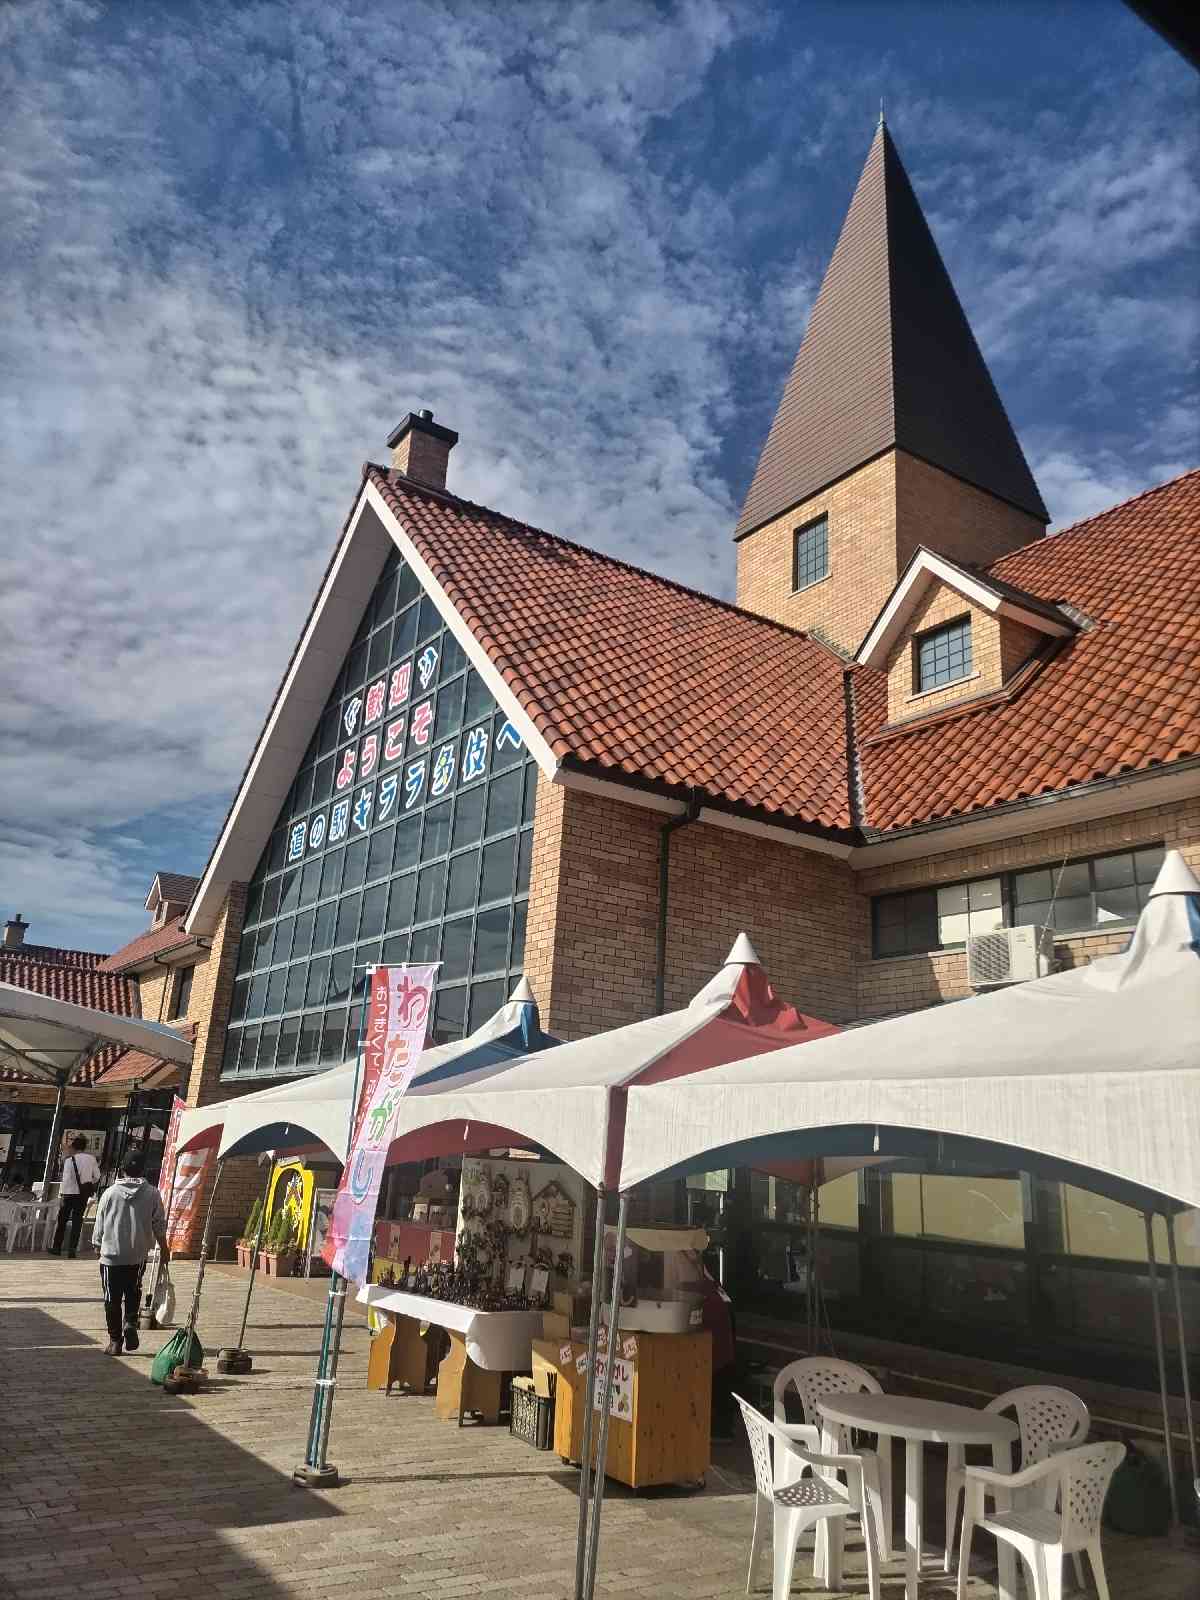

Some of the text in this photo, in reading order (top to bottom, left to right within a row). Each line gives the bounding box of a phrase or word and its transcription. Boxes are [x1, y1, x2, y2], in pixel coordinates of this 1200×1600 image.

[337, 700, 433, 789] ようこそ
[351, 976, 430, 1205] わたがし
